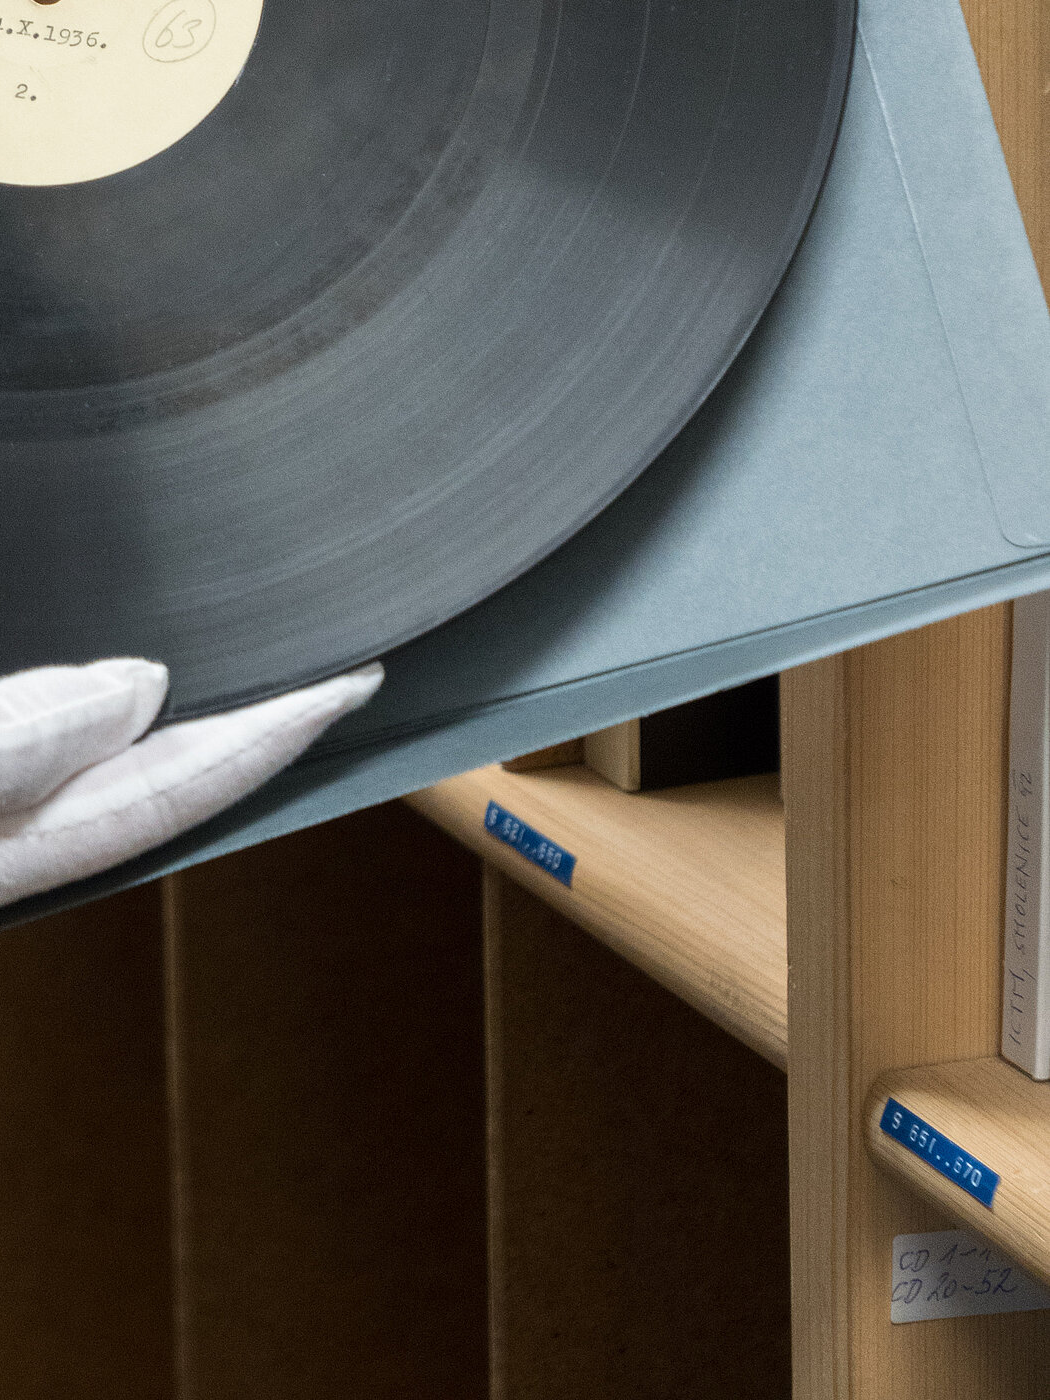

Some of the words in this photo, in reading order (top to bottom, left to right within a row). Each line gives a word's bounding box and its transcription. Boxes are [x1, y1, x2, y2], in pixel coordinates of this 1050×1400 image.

[155, 9, 203, 49] 63
[14, 82, 37, 102] 2.
[891, 1111, 903, 1130] S
[909, 1124, 983, 1189] 651..670
[900, 1249, 930, 1273] CD
[892, 1278, 923, 1304] CD
